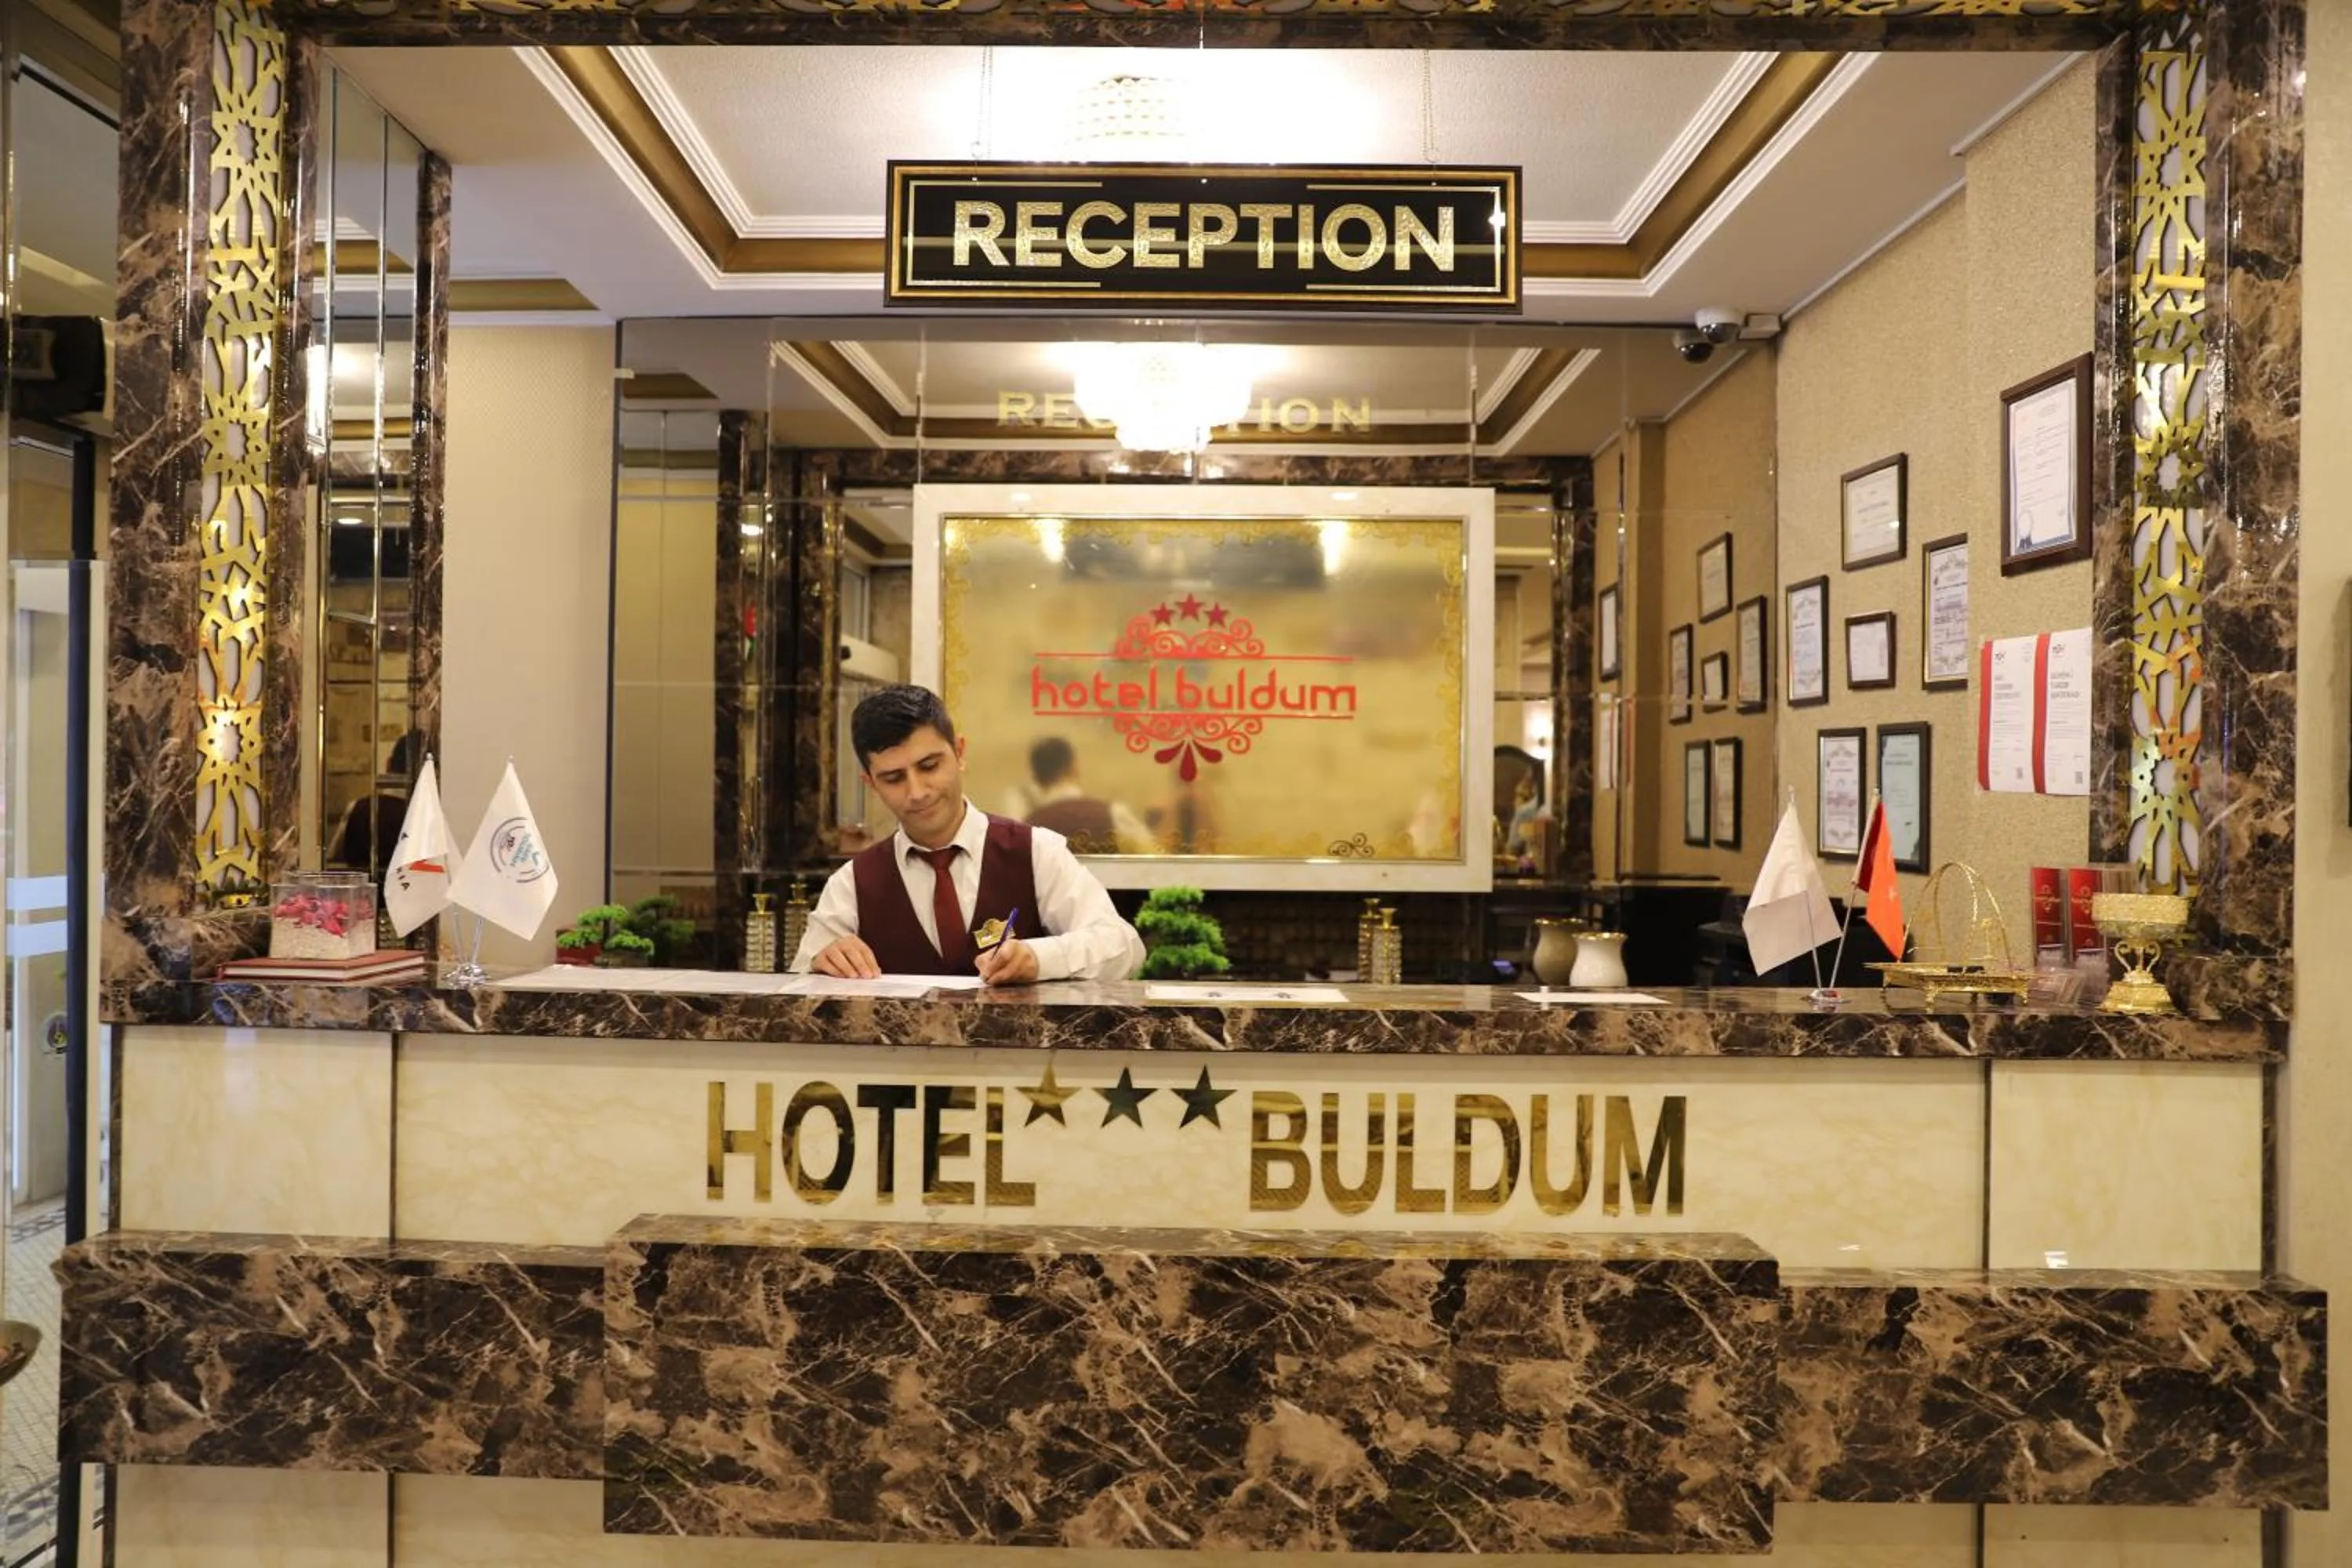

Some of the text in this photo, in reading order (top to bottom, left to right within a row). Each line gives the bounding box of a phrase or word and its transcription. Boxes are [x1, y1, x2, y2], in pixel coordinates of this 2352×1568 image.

[952, 198, 1455, 273] RECEPTION
[996, 390, 1371, 436] REION
[1031, 664, 1357, 712] hotel buldum
[707, 1080, 1687, 1218] HOTEL BULDUM
